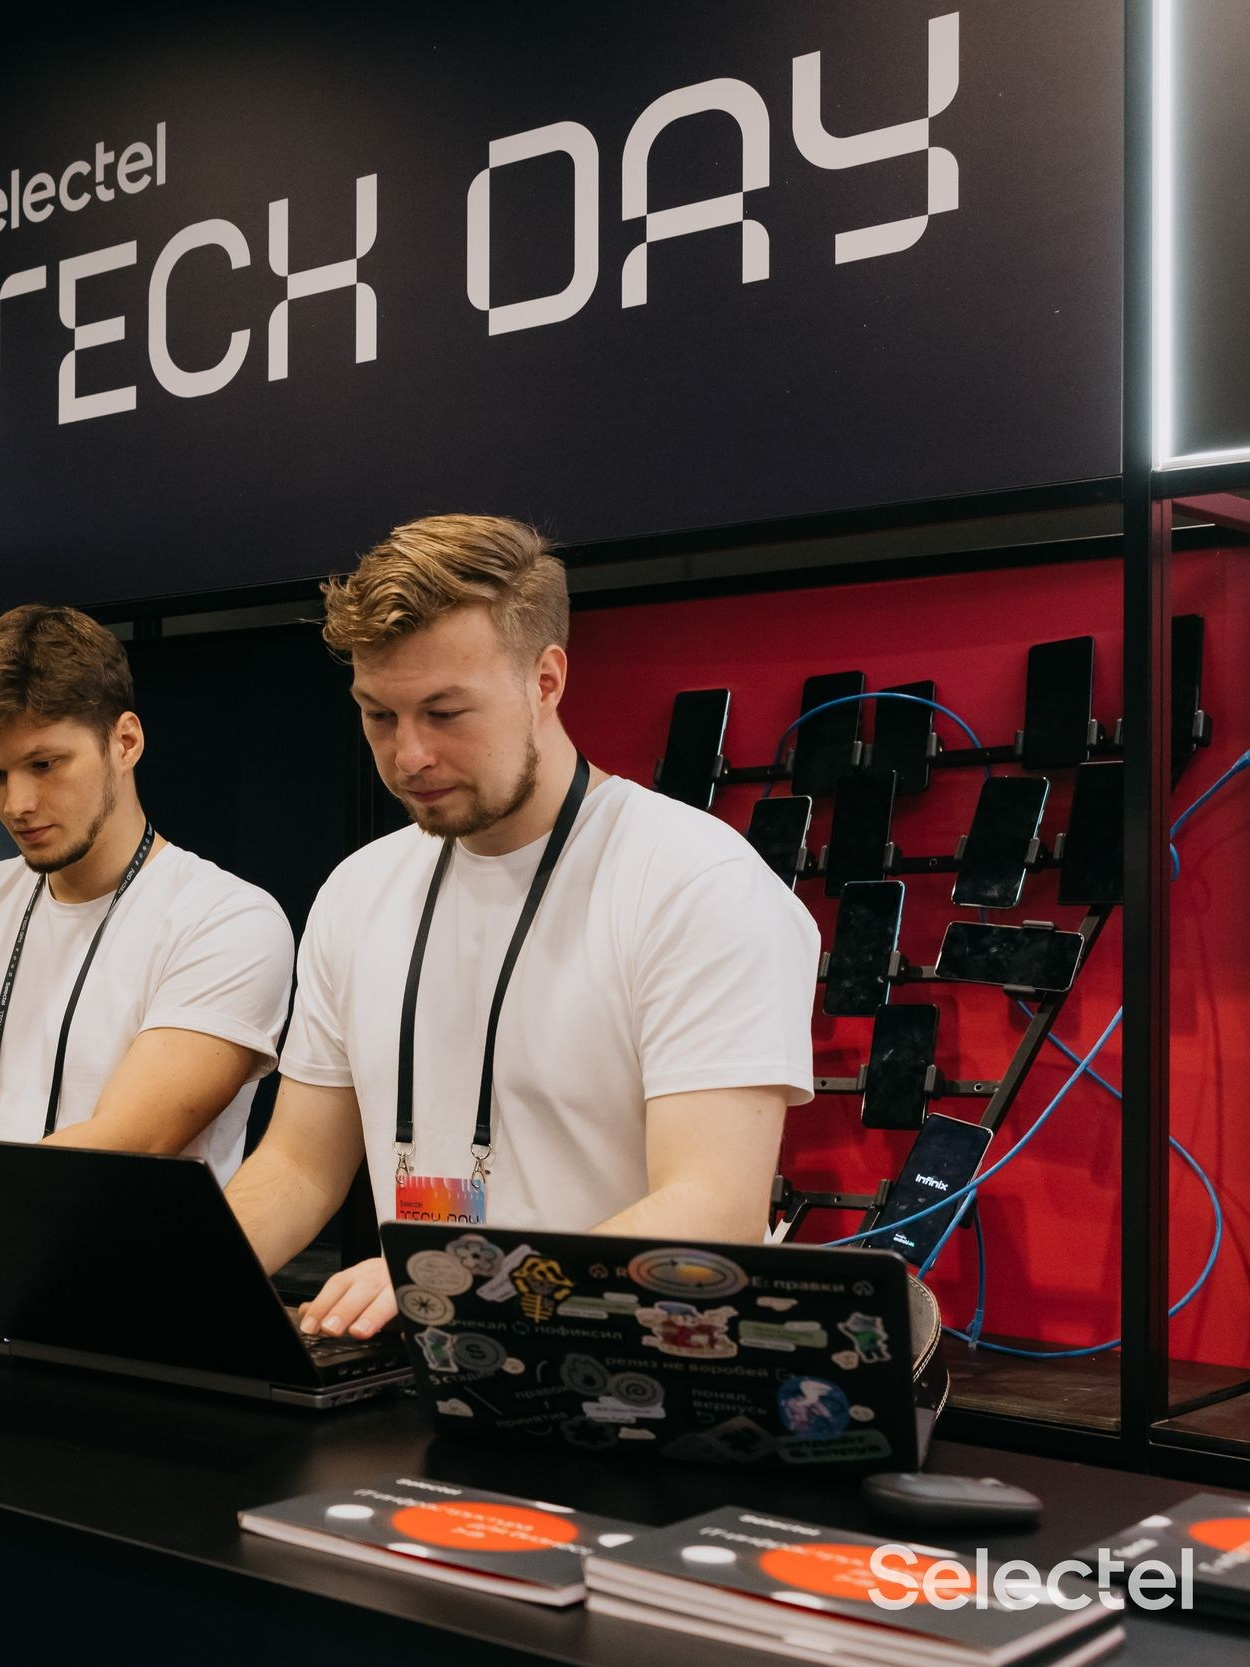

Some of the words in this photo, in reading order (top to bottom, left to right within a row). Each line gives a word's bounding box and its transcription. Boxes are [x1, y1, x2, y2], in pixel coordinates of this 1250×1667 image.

[466, 11, 960, 337] DAY
[915, 1173, 949, 1191] Infinix
[399, 1200, 423, 1208] Selectel
[773, 1278, 845, 1293] правки
[534, 1326, 623, 1340] пофиксил
[605, 1357, 658, 1369] релиз
[662, 1361, 684, 1371] не
[688, 1362, 769, 1377] воробей
